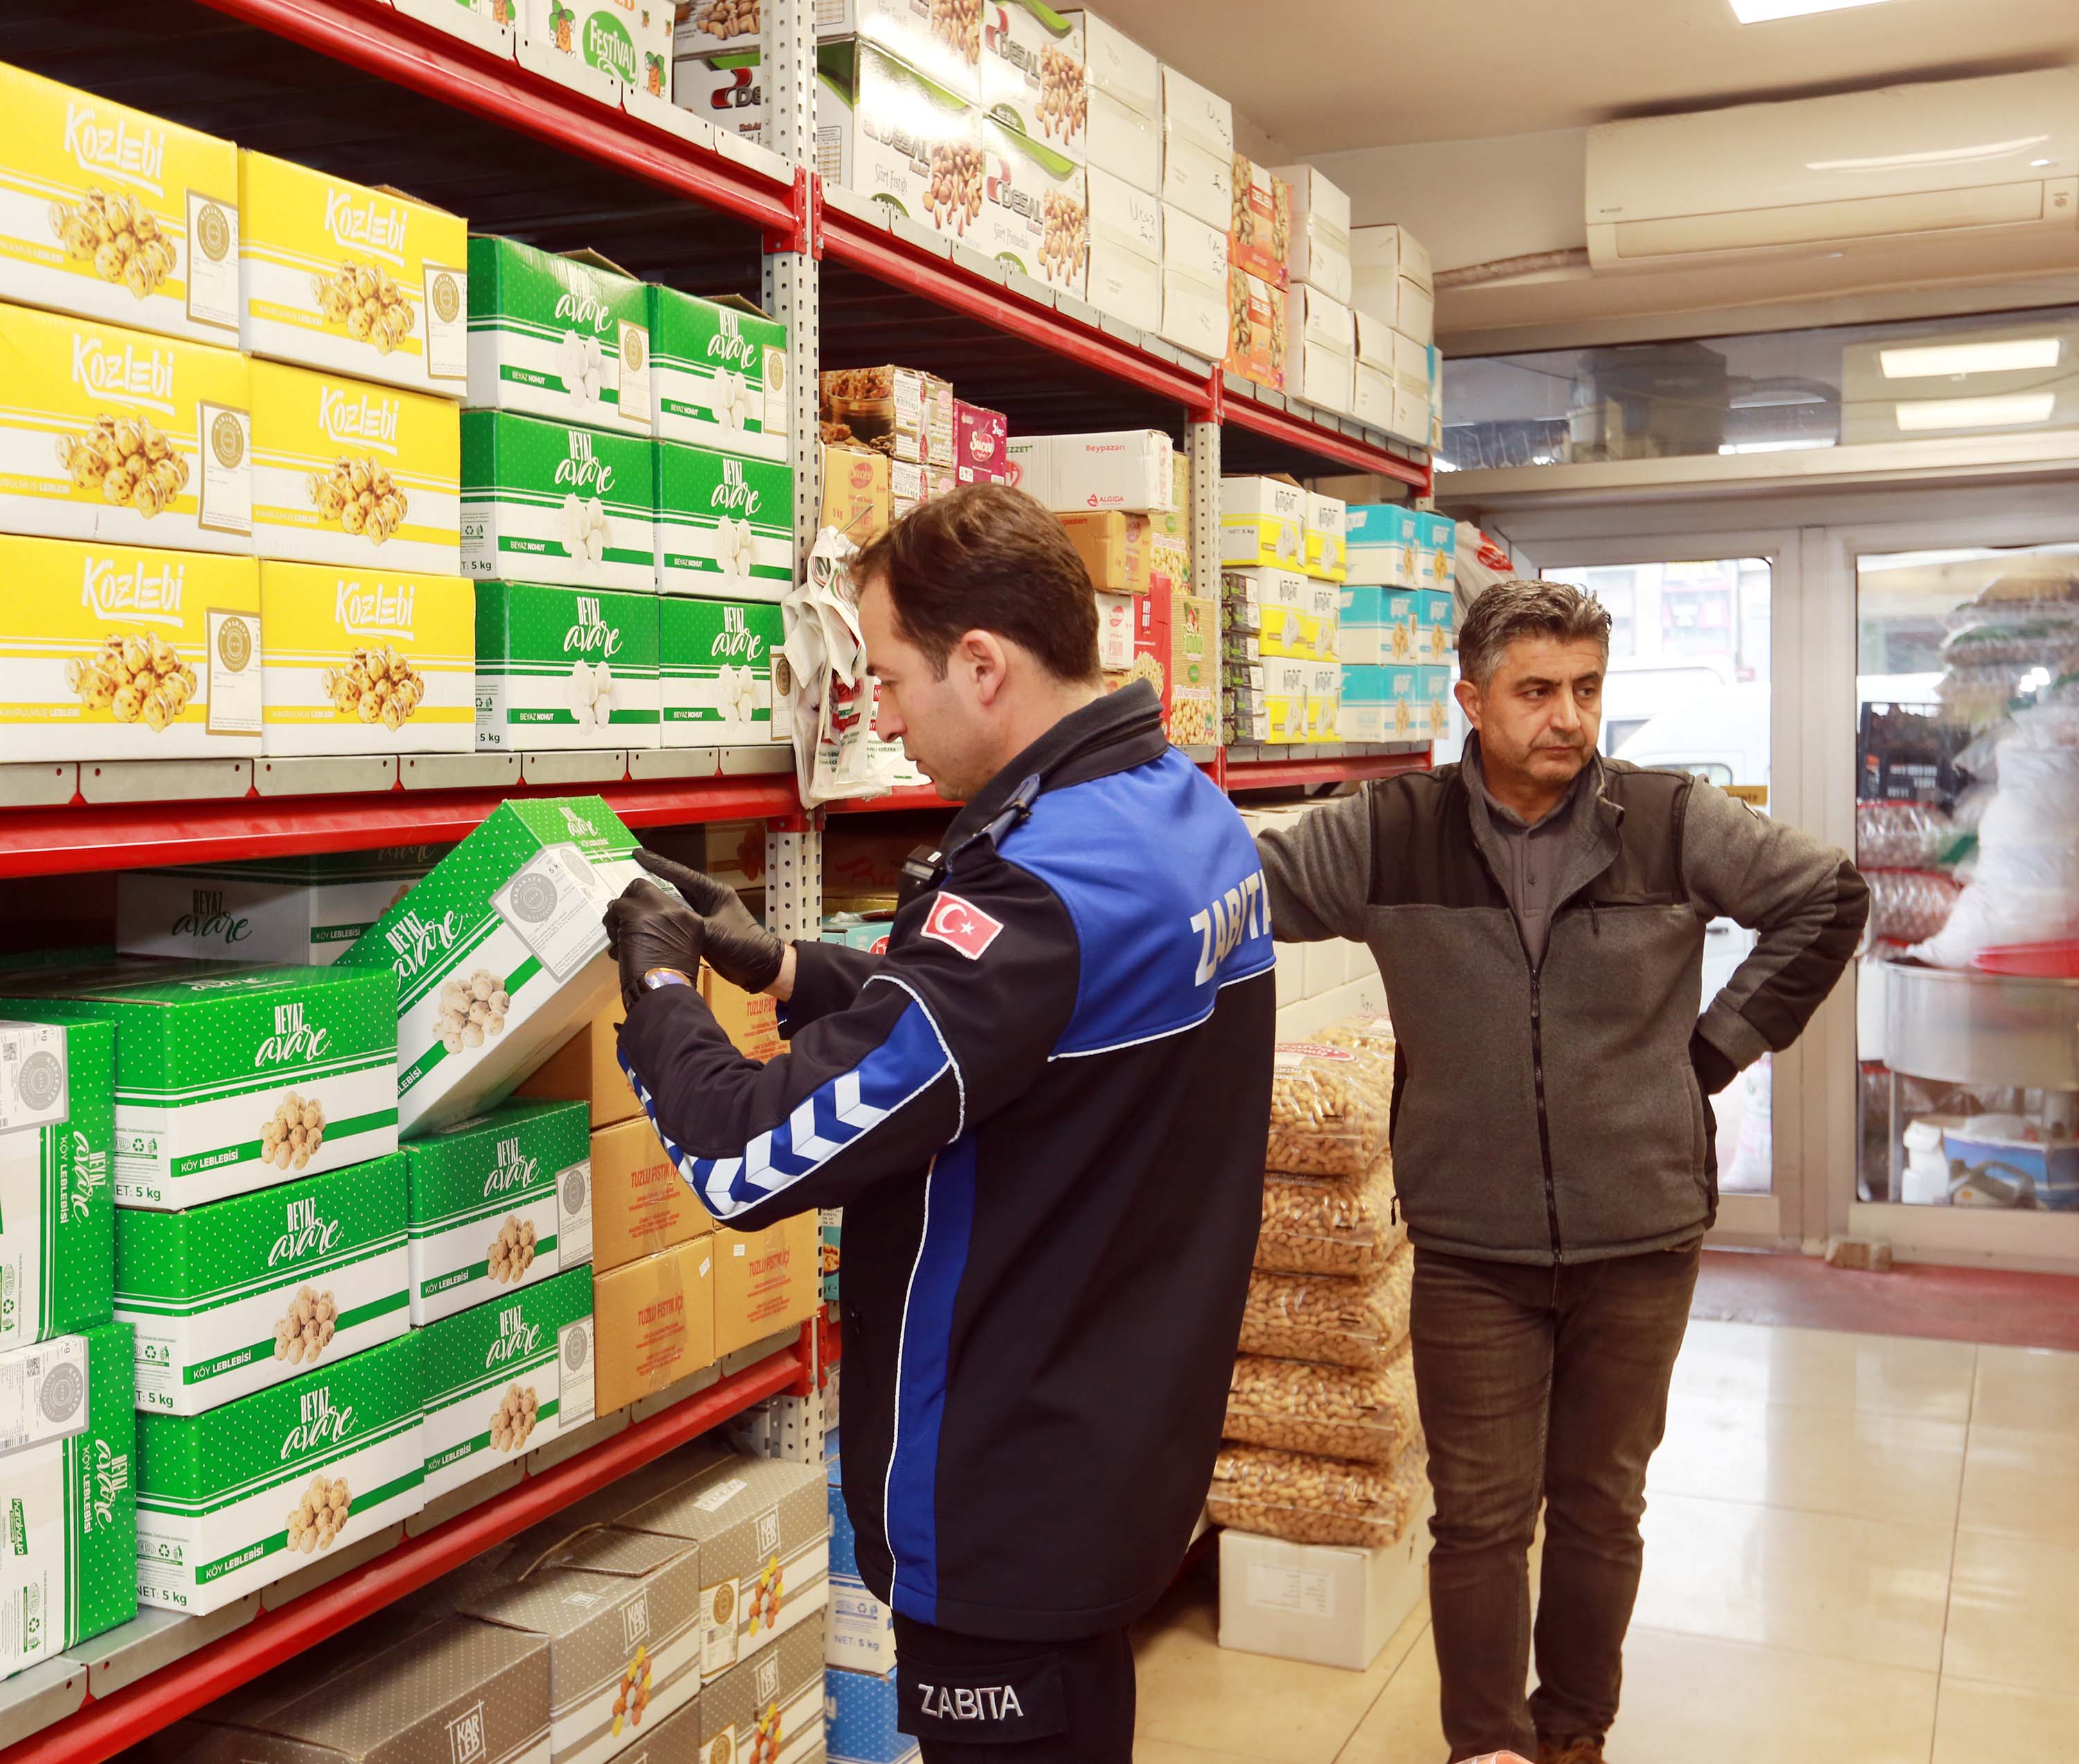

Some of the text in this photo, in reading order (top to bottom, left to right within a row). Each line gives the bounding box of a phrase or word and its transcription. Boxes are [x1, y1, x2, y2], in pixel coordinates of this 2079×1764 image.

[555, 293, 613, 334] avare
[707, 334, 757, 369] avare
[568, 430, 593, 461] BEYAZ
[554, 457, 615, 495] avare
[722, 458, 742, 486] BEYAZ
[711, 482, 762, 516] avare
[510, 540, 527, 550] BEYAZ
[471, 561, 477, 570] 5
[480, 561, 492, 572] kg
[576, 596, 601, 626] BEYAZ
[723, 606, 744, 634] BEYAZ
[563, 620, 623, 658] avare
[711, 628, 764, 662] avare
[519, 712, 554, 721] BEYAZ NOHUT
[480, 732, 500, 744] 5 kg
[193, 890, 223, 915] BEYAZ
[171, 910, 253, 944] avare
[385, 910, 426, 955] BEYAZ
[392, 910, 464, 991] avare
[274, 1002, 304, 1035] BEYAZ
[746, 998, 764, 1017] TUZLU
[254, 1024, 331, 1068] avare
[398, 1066, 423, 1095] LEBİSİ
[89, 1150, 106, 1186] BEYAZ
[180, 1149, 239, 1173] KÖY LEBLEBİSİ
[497, 1140, 521, 1164] BEYAZ
[59, 1136, 70, 1224] KÖY LEBLEBİSİ
[71, 1131, 94, 1224] avare
[116, 1185, 161, 1201] ET: 5 kg
[484, 1155, 541, 1199] avare
[631, 1167, 651, 1189] TUZLU
[287, 1198, 316, 1232] BEYAZ
[267, 1217, 344, 1267] avare
[424, 1270, 469, 1294] KÖY LEBLEBİSİ
[500, 1305, 523, 1330] BEYAZ
[638, 1305, 656, 1326] TUZLU
[486, 1322, 544, 1370] avare
[193, 1350, 252, 1380] KÖY LEBLEBİSİ
[148, 1392, 156, 1404] 5
[159, 1393, 174, 1409] kg
[300, 1386, 330, 1421] BEYAZ
[280, 1404, 358, 1461] avare
[110, 1453, 128, 1491] BEYAZ
[428, 1443, 472, 1471] KÖY LEBLEBİSİ
[82, 1445, 93, 1534] KÖY LEBLEBİSİ
[94, 1438, 114, 1532] avare
[205, 1543, 264, 1580] KÖY LEBLEBİSİ
[161, 1587, 168, 1600] 5
[171, 1588, 185, 1603] kg
[628, 1599, 645, 1621] KAR
[866, 1639, 880, 1652] kg
[918, 1683, 1024, 1722] ZABITA
[457, 1713, 480, 1745] KAR
[458, 1734, 480, 1763] LEB
